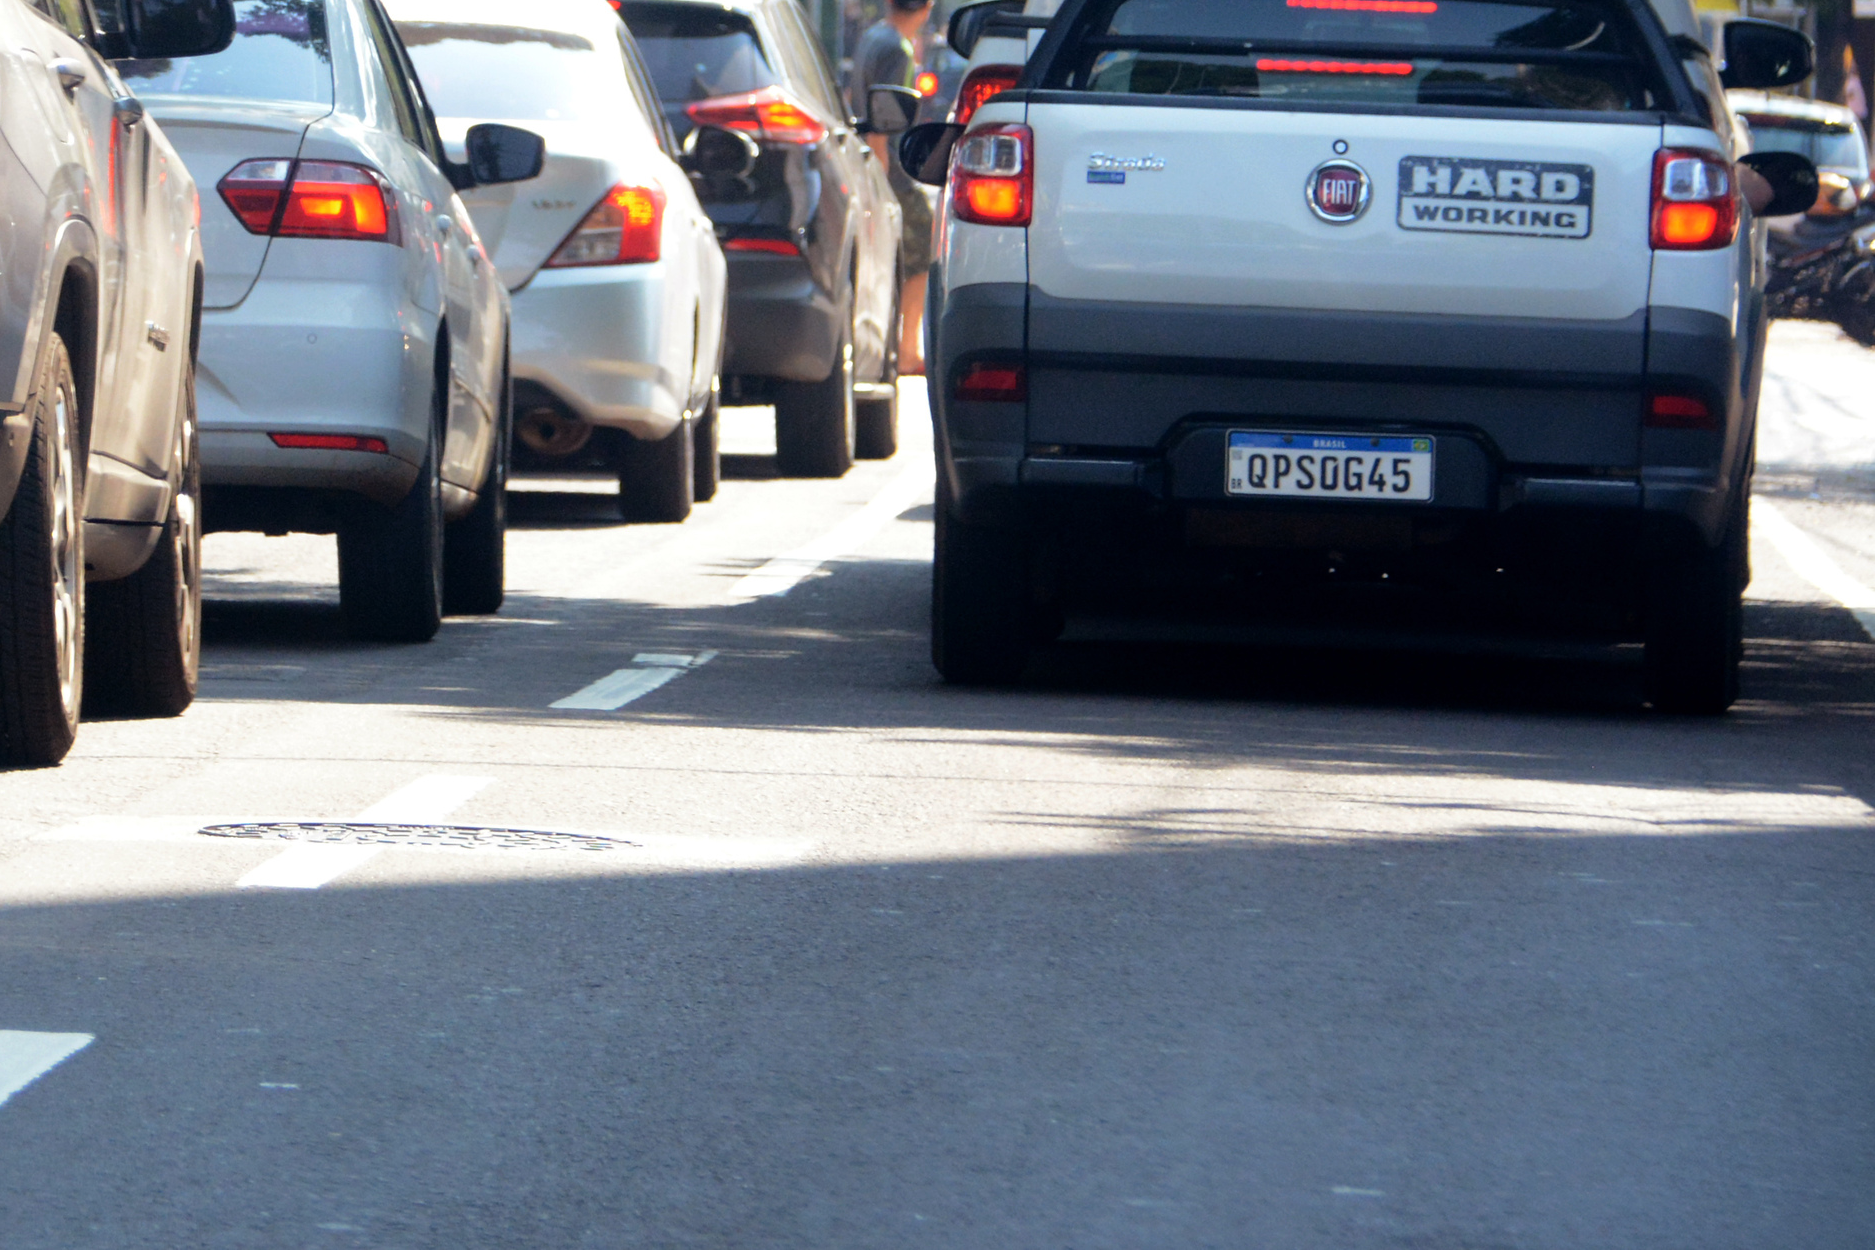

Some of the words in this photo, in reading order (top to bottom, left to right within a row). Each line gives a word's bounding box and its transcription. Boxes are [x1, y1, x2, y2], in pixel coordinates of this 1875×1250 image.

[1087, 151, 1167, 171] Strada
[1323, 177, 1358, 206] FIAT
[1411, 164, 1581, 202] HARD
[1413, 204, 1578, 229] WORKING
[1313, 440, 1346, 449] BRASIL
